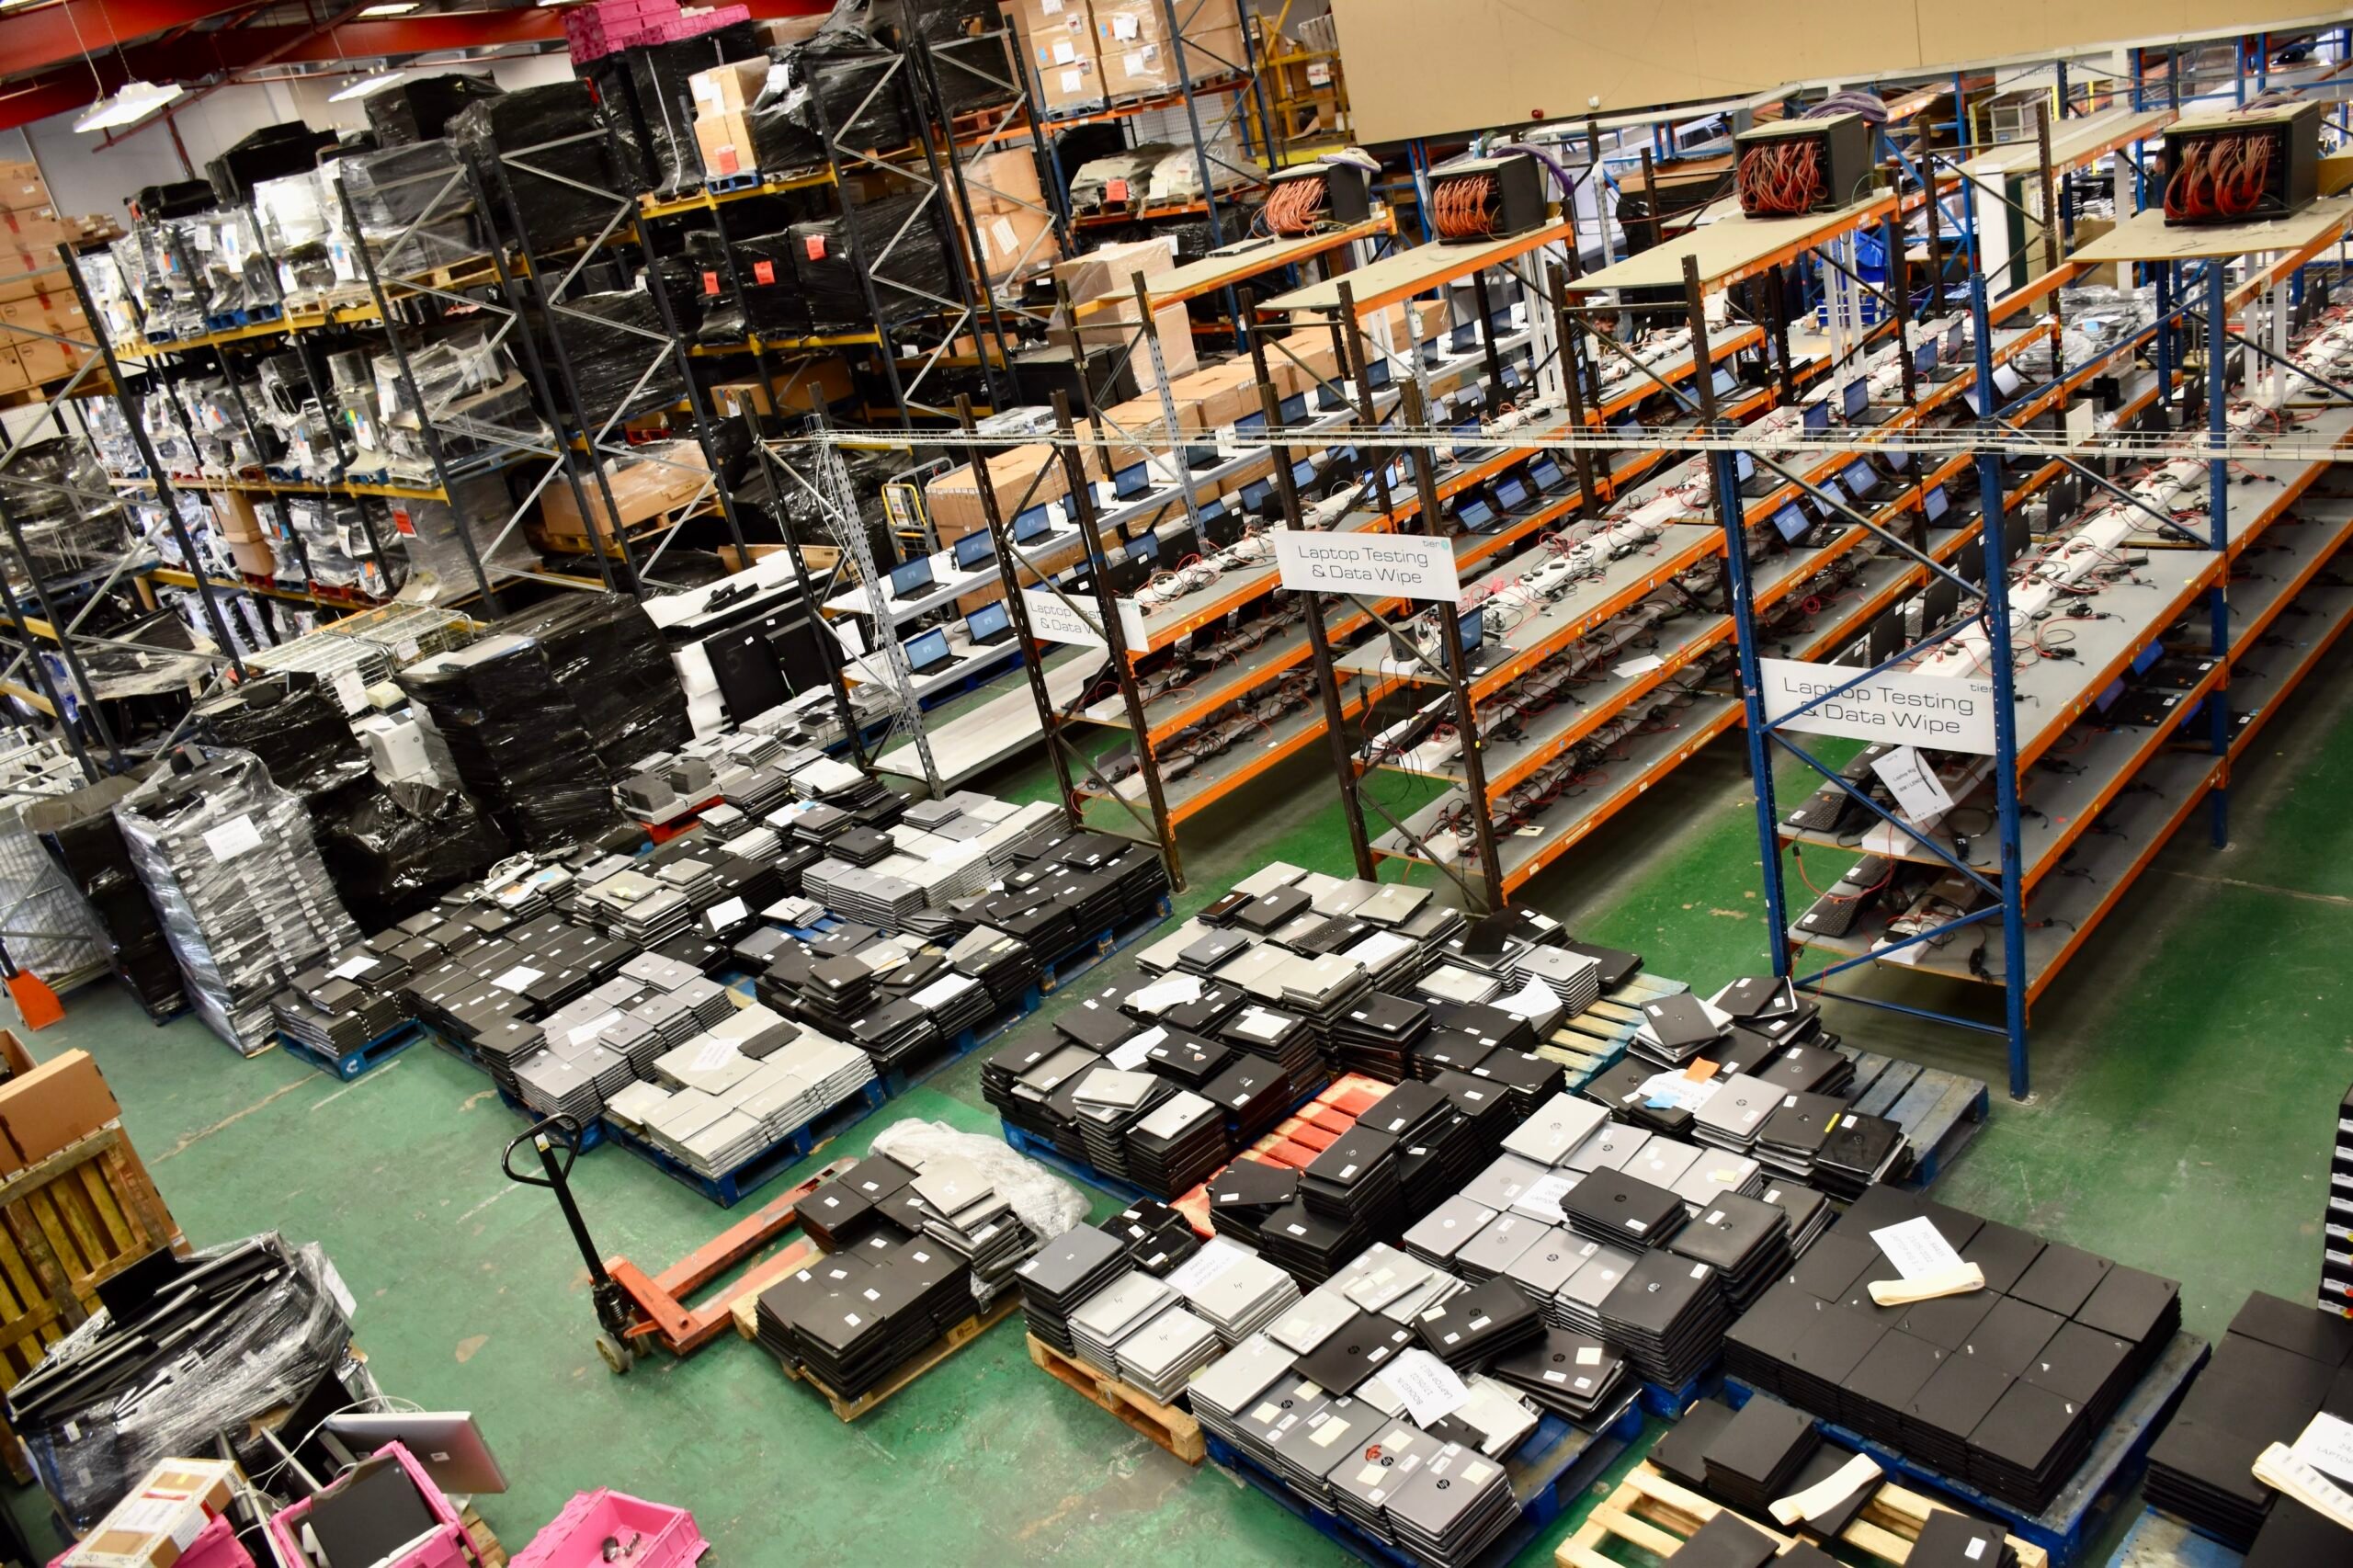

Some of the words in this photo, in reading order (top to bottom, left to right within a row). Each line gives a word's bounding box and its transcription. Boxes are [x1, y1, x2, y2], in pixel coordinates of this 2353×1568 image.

[1298, 545, 1360, 563] Laptop
[1362, 547, 1429, 568] Testing
[1312, 564, 1326, 578] &
[1329, 565, 1372, 581] Data
[1375, 567, 1423, 586] Wipe
[1029, 601, 1072, 619] Laptop
[1040, 618, 1050, 629] &
[1051, 619, 1082, 633] Data
[1876, 686, 1973, 716] Testing
[1825, 703, 1886, 725] Data
[1892, 711, 1961, 735] Wipe
[1893, 772, 1908, 781] Laptop
[1909, 775, 1928, 787] LENOO
[1432, 1377, 1453, 1399] LAPTOP
